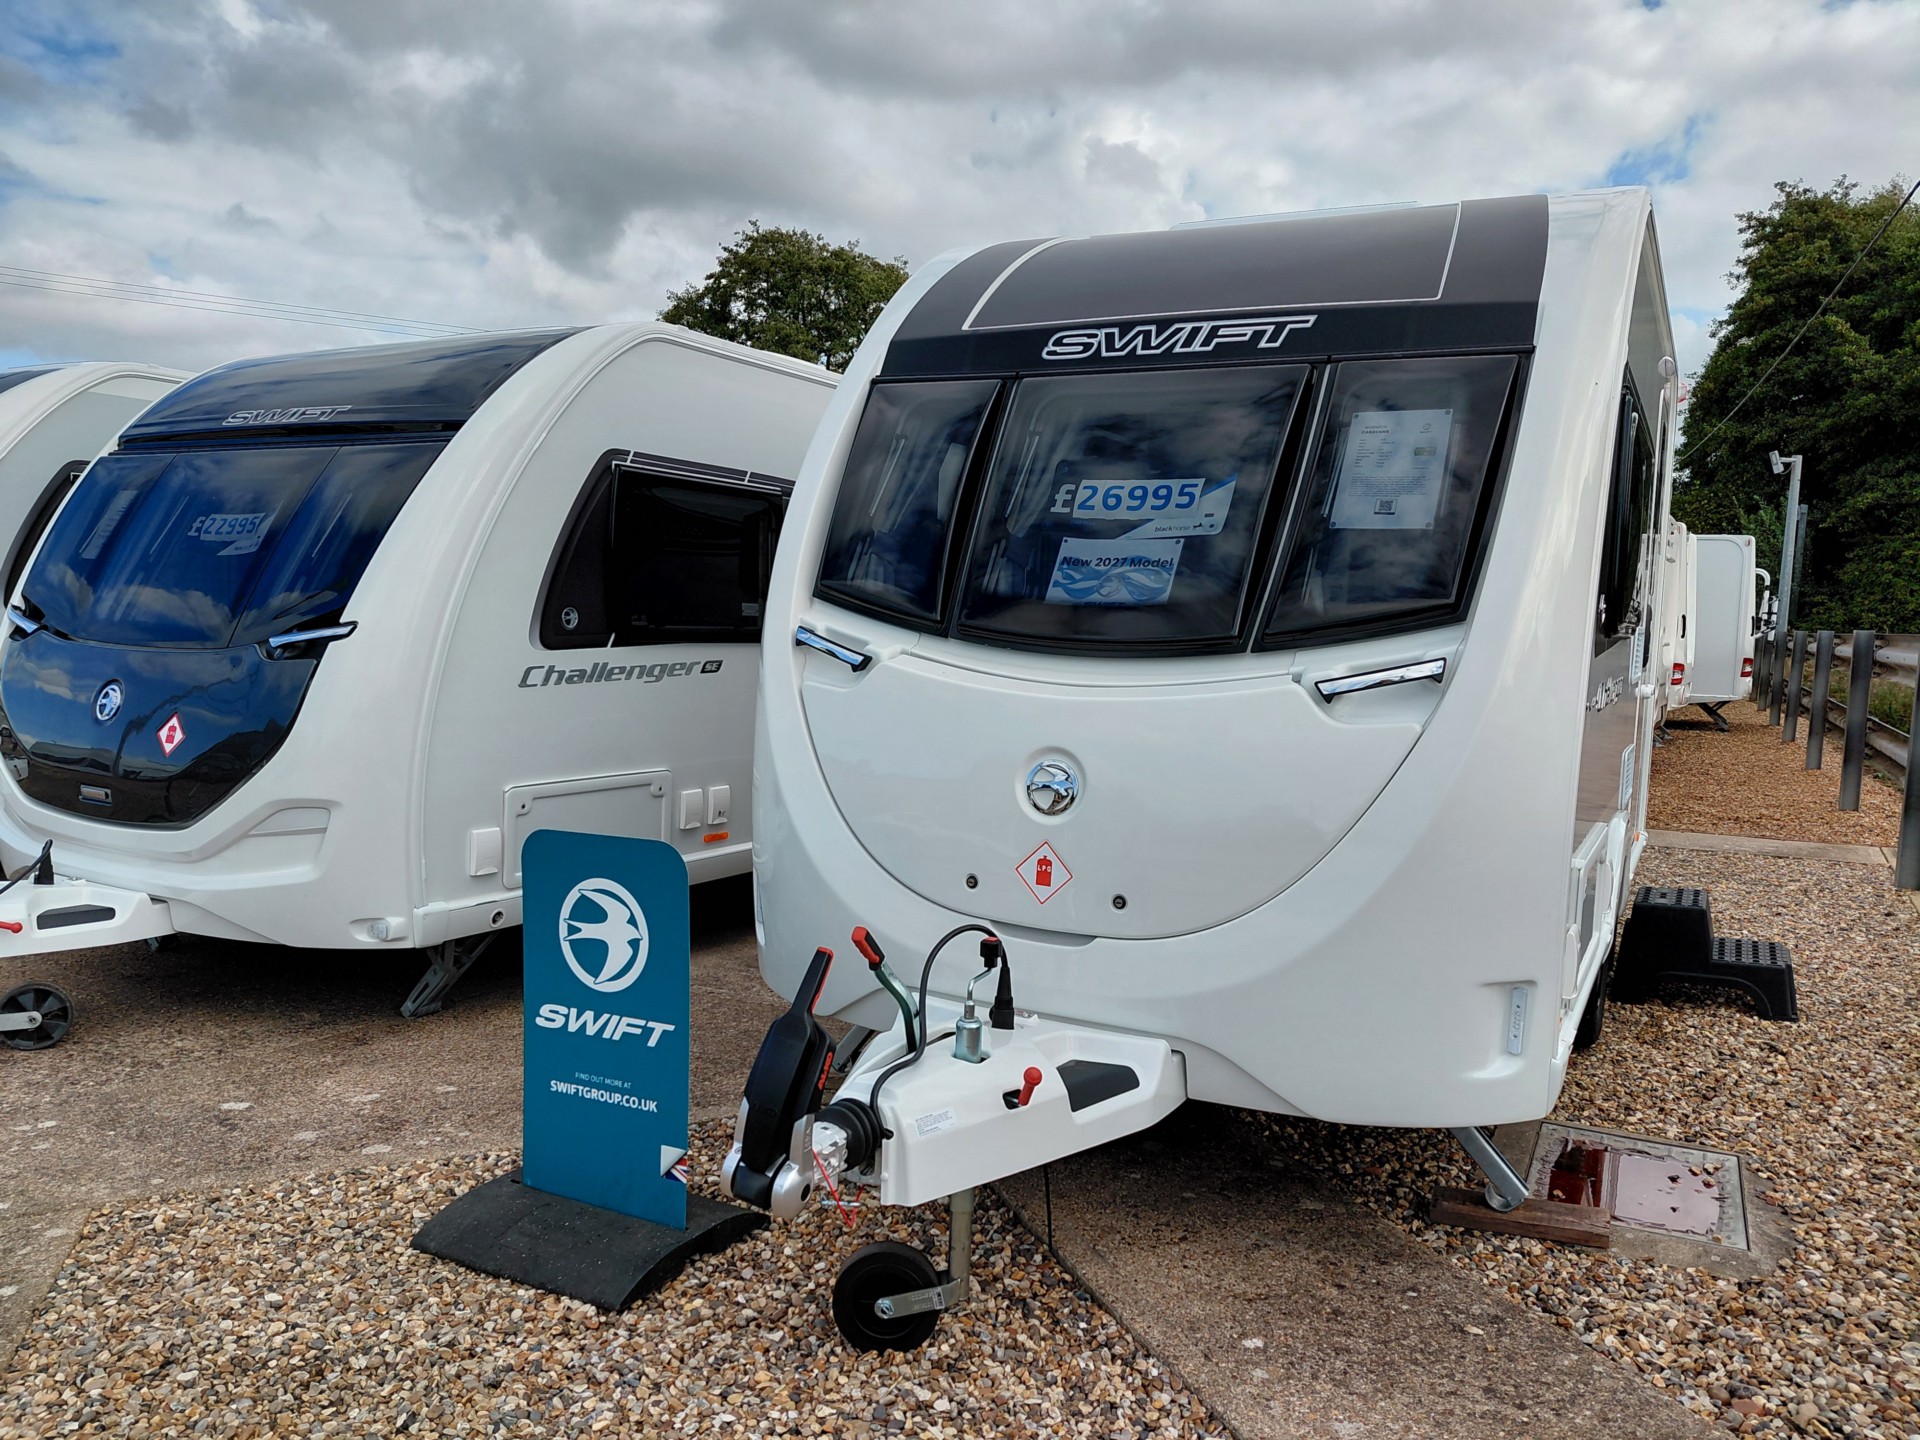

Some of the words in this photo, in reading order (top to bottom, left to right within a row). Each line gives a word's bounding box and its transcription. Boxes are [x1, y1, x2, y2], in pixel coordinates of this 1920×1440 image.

[1041, 314, 1318, 360] SWIFT
[222, 404, 353, 426] SWIFT
[1050, 483, 1199, 513] £26995
[187, 516, 260, 536] £22995
[1061, 556, 1092, 568] New
[1095, 556, 1128, 568] 2027
[1129, 556, 1174, 569] Model
[517, 660, 702, 689] Challenger
[703, 661, 721, 673] SE
[1037, 864, 1052, 872] LPG
[535, 1003, 676, 1048] SWIFT
[575, 1072, 590, 1081] FIND
[590, 1074, 604, 1084] OUT
[604, 1077, 623, 1088] MORE
[623, 1081, 632, 1089] AT
[550, 1079, 658, 1113] SWIFTGROUP.CO.UK
